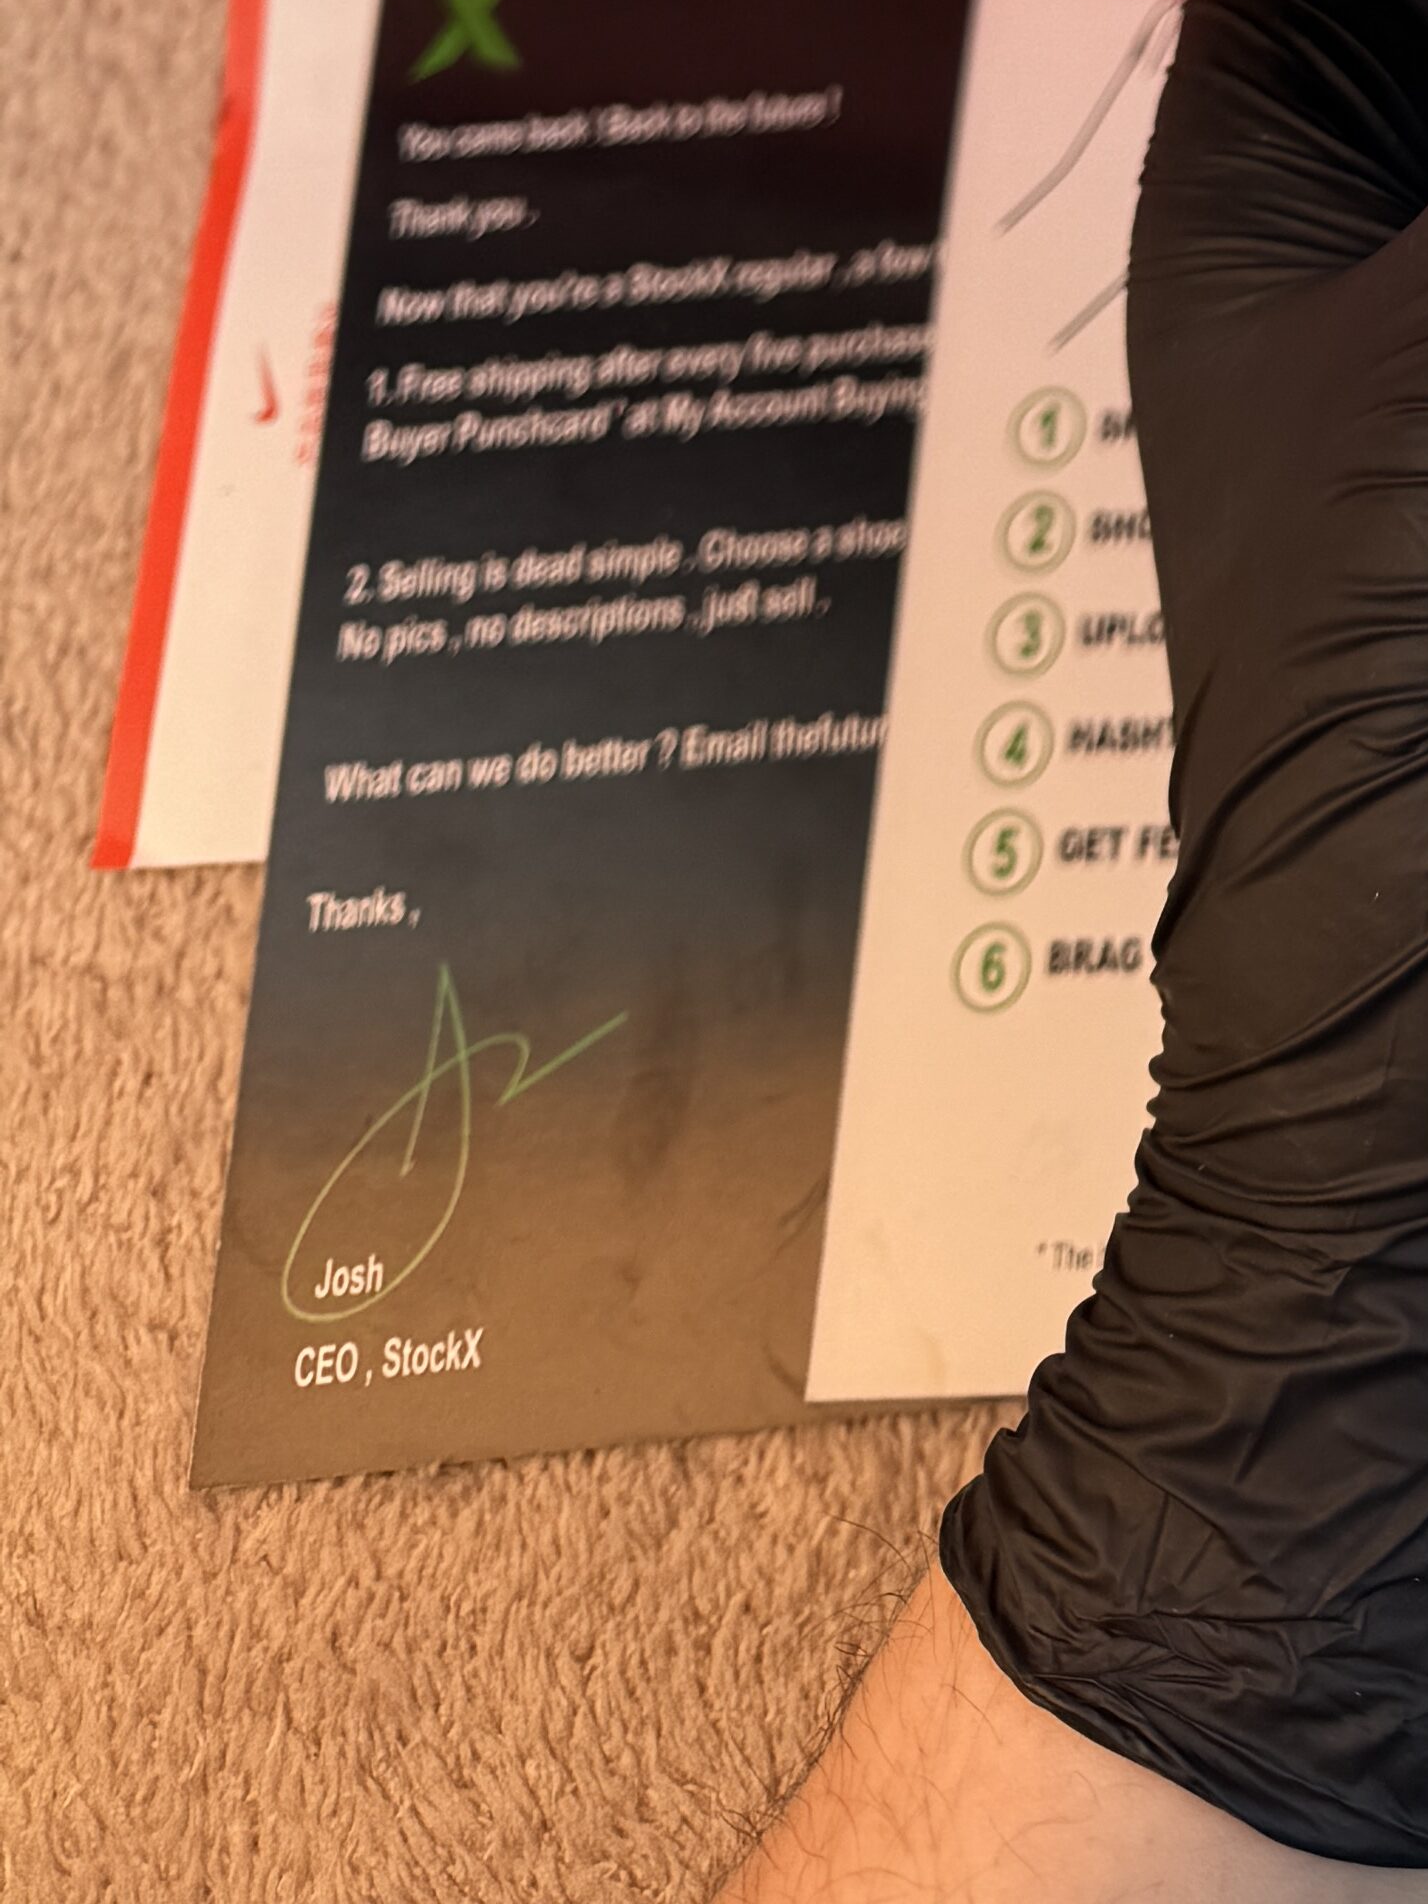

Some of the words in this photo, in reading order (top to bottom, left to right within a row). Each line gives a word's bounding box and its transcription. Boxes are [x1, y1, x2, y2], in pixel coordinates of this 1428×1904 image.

[390, 197, 467, 240] Thank
[377, 287, 444, 326] Now
[450, 279, 507, 320] that
[601, 274, 623, 309] a
[397, 363, 463, 404] Free
[466, 352, 592, 402] shipping
[595, 344, 658, 387] after
[660, 343, 743, 383] every
[362, 418, 450, 467] Buyer
[660, 393, 703, 442] My
[703, 386, 827, 432] Account
[377, 555, 477, 604] Selling
[478, 550, 507, 592] is
[509, 542, 585, 589] dead
[586, 534, 683, 585] simple
[699, 528, 809, 572] Choose
[810, 526, 833, 563] a
[337, 620, 382, 662] No
[382, 614, 447, 667] pics
[466, 613, 507, 649] no
[509, 594, 686, 647] descriptions
[699, 580, 760, 638] just
[760, 575, 816, 623] sell
[325, 759, 402, 803] What
[405, 758, 463, 797] can
[467, 754, 513, 790] we
[515, 742, 558, 785] do
[560, 737, 652, 781] better
[680, 716, 768, 771] Email
[1057, 826, 1125, 865] GET
[308, 884, 406, 933] Thanks
[1045, 936, 1143, 975] BRAG
[314, 1253, 384, 1299] Josh
[1050, 1239, 1094, 1272] The
[294, 1341, 359, 1387] CEO
[381, 1327, 484, 1378] StockX
